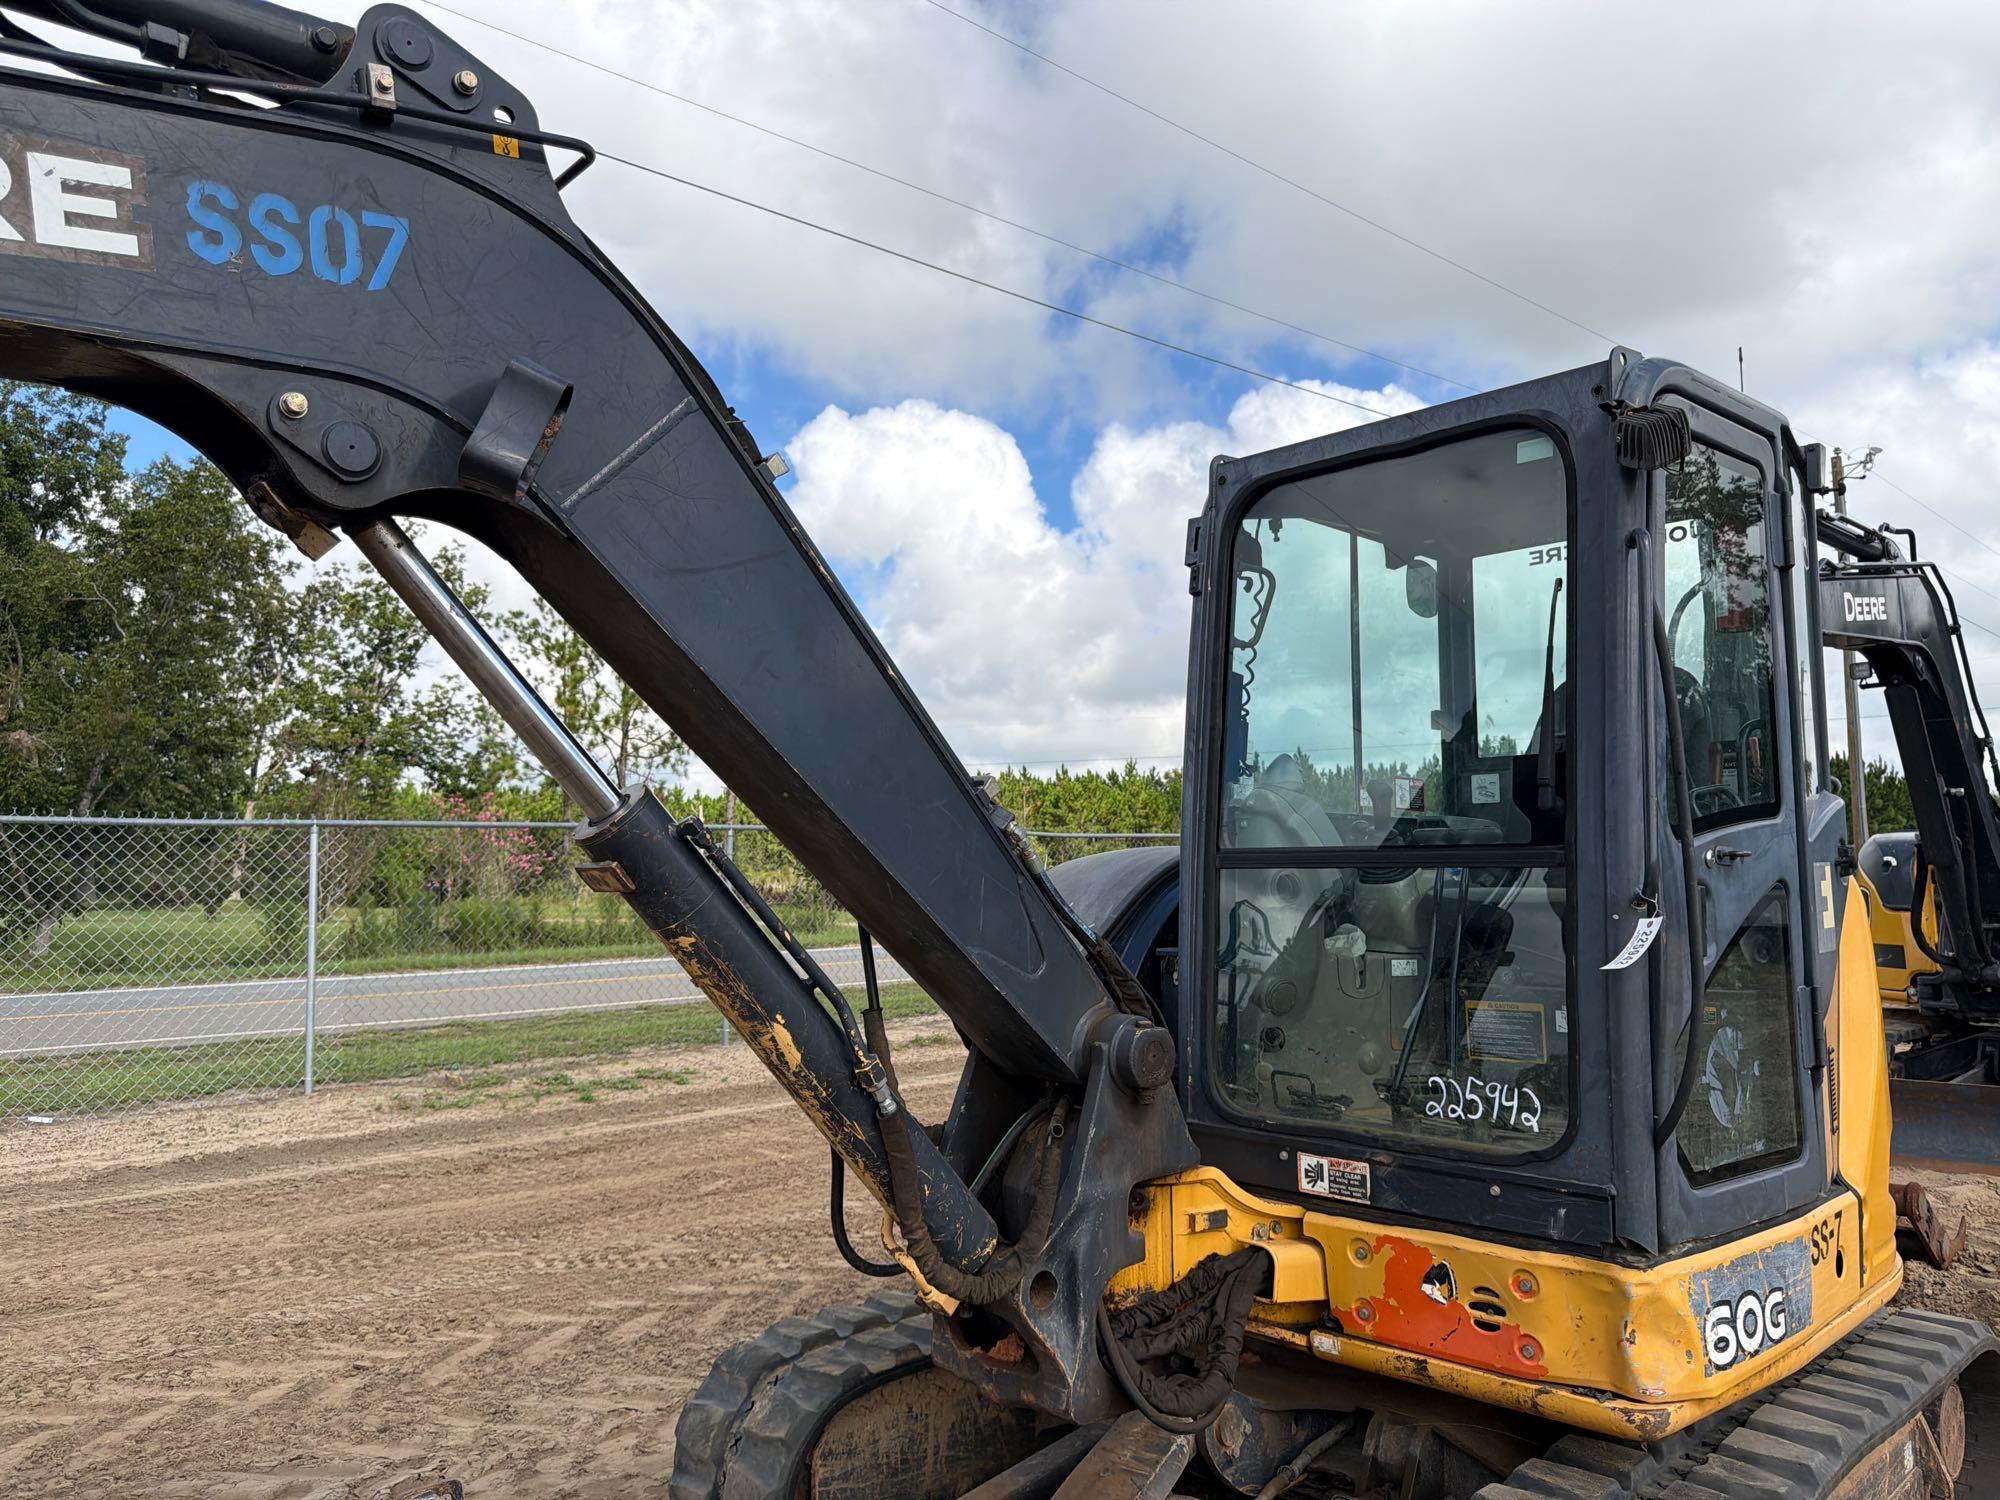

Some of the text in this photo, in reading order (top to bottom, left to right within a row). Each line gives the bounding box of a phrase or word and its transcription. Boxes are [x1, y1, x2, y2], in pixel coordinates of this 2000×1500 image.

[0, 152, 140, 257] E
[186, 179, 411, 291] SS07
[1425, 1076, 1541, 1133] 225942
[1811, 1210, 1843, 1266] SS-7
[1704, 1287, 1787, 1371] 60G
